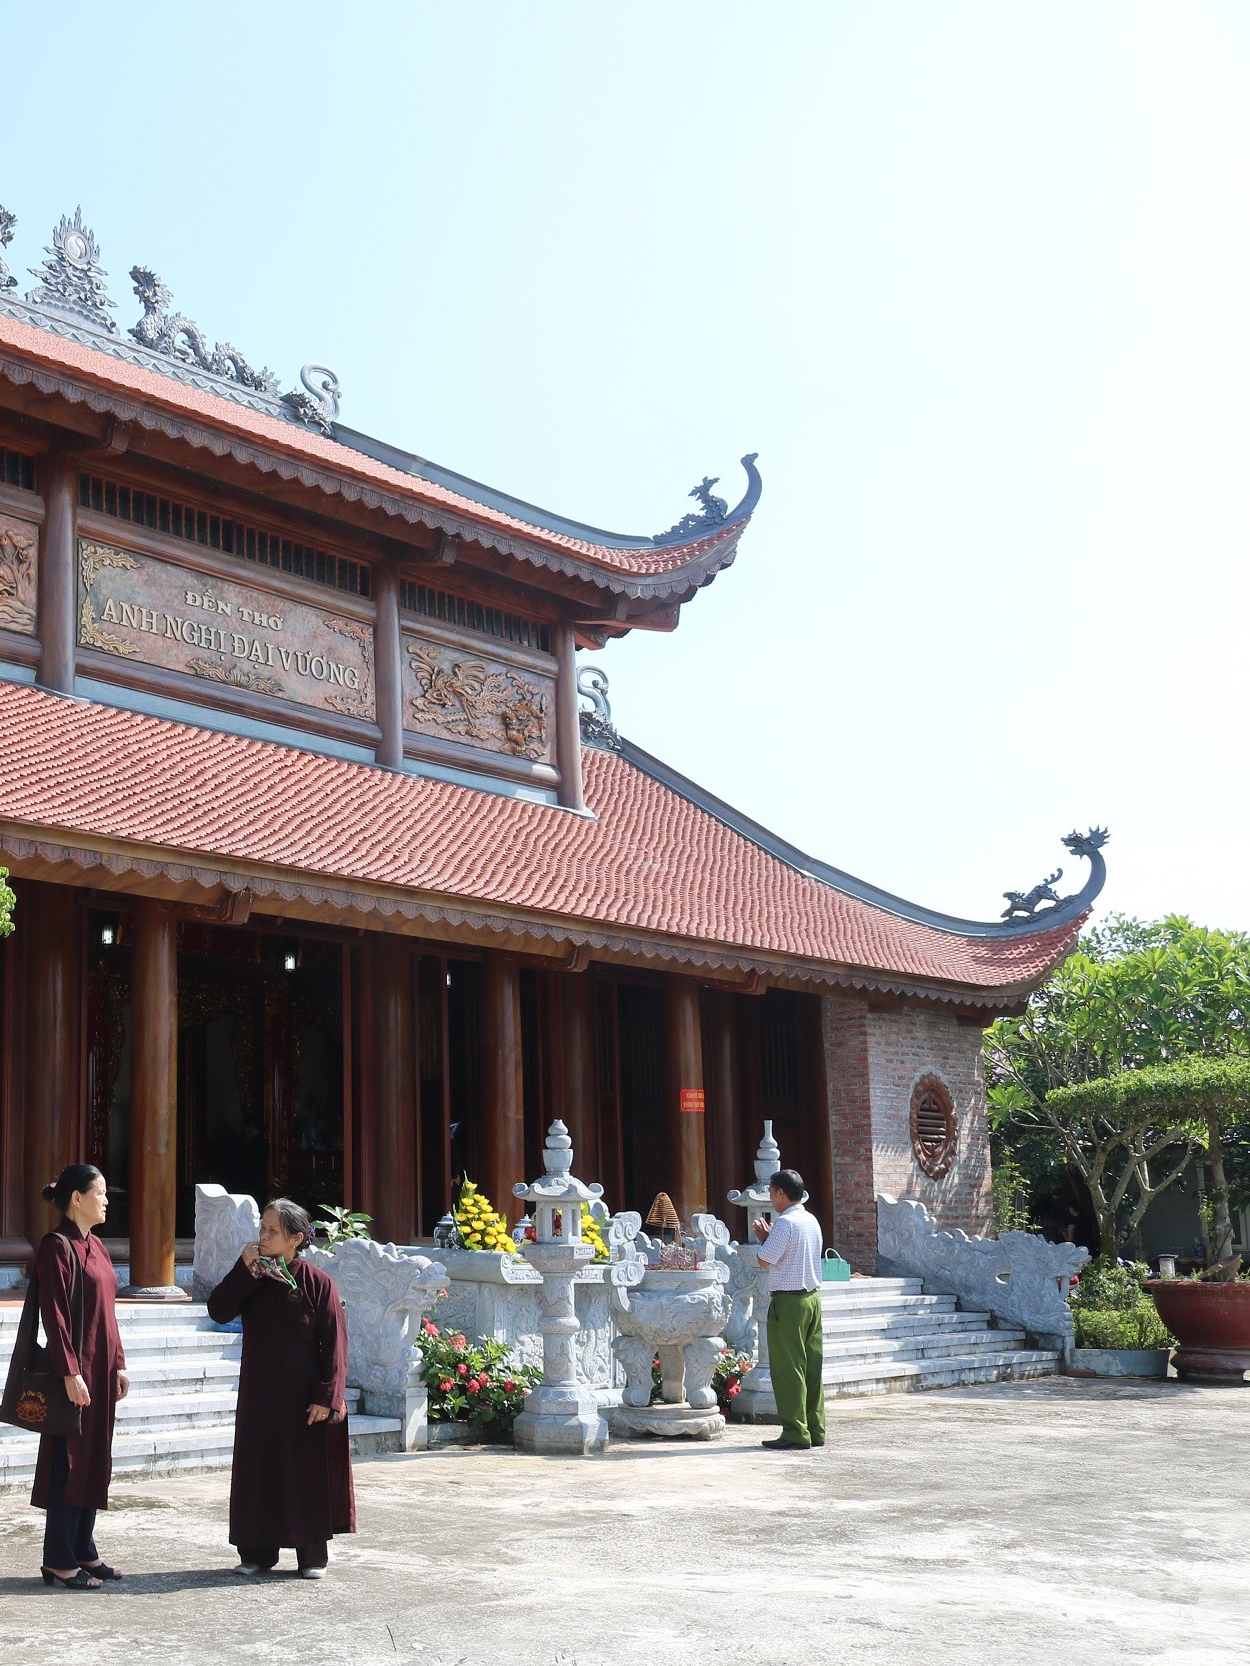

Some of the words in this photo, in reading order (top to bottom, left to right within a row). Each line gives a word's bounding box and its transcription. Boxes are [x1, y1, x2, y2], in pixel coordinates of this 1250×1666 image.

[101, 598, 160, 635] ANH
[164, 613, 228, 661] NGHỊ
[231, 632, 275, 670] ĐẠI
[278, 647, 361, 690] VƯƠNG
[184, 589, 233, 618] ĐỀN
[238, 606, 284, 632] THỜ
